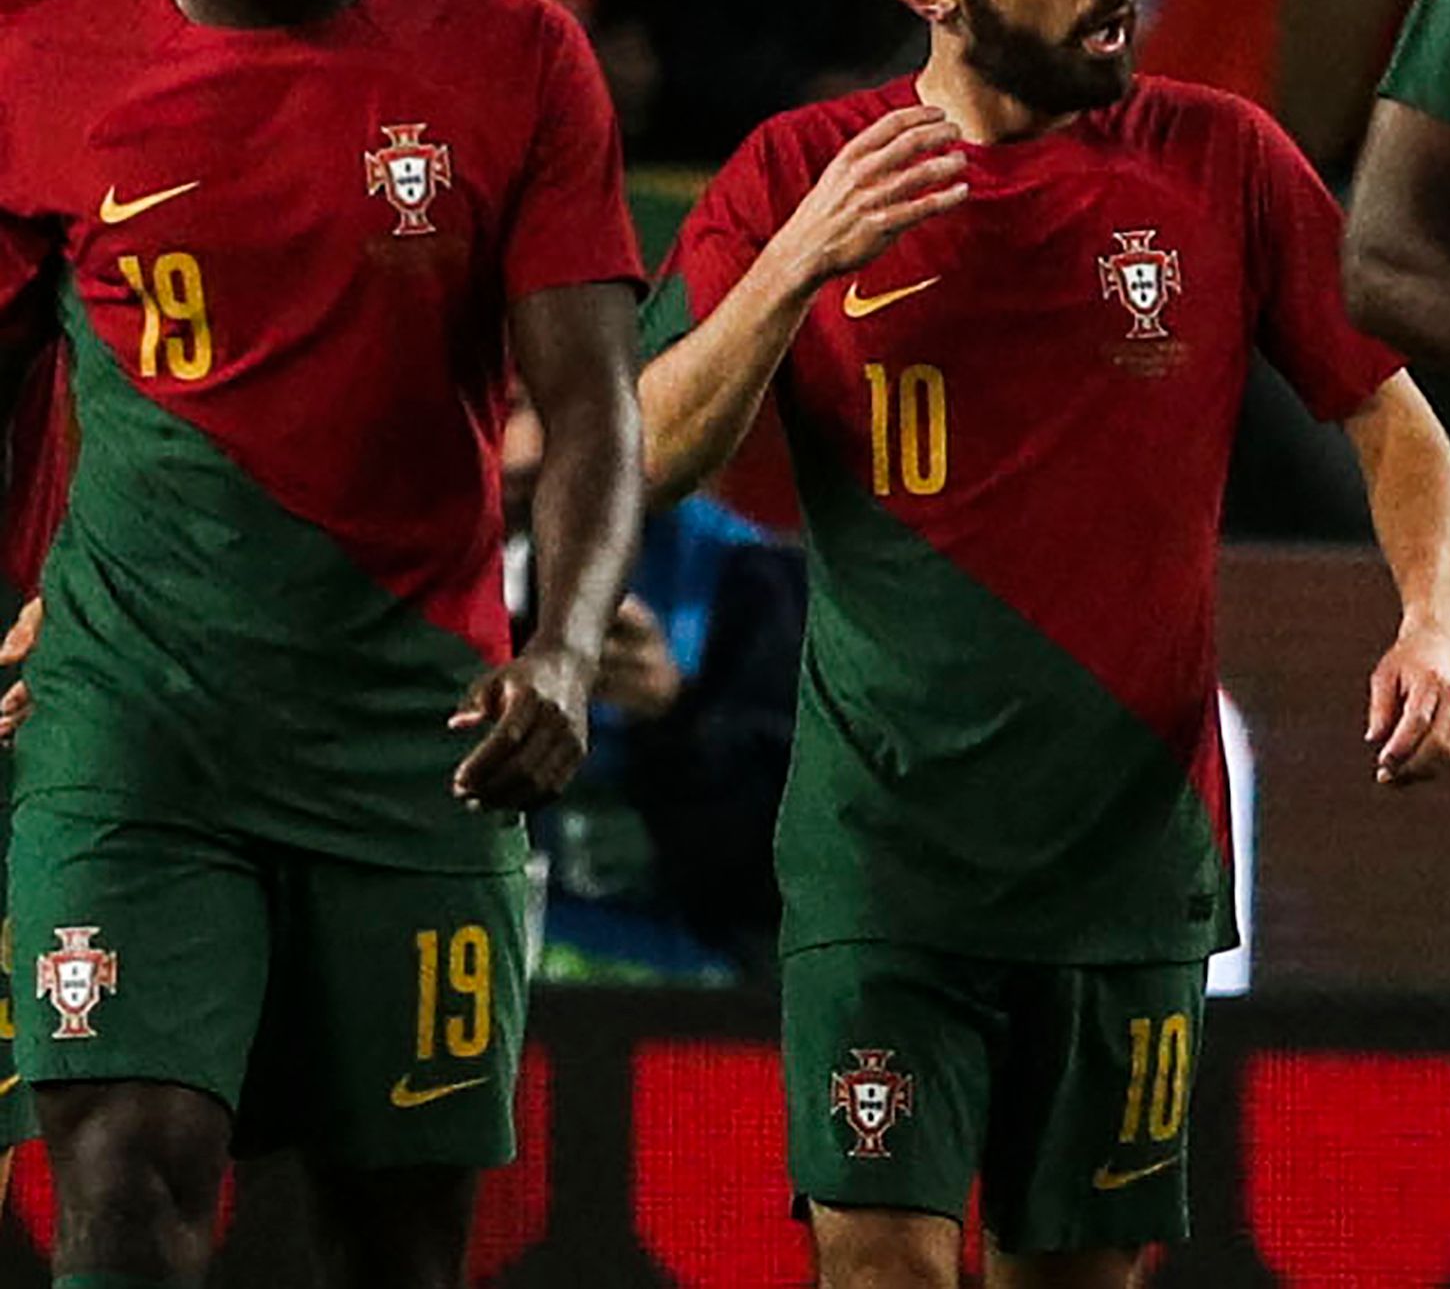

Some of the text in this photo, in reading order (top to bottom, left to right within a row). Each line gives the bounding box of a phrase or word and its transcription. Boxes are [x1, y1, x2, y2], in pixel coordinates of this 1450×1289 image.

[117, 252, 214, 381] 19
[863, 362, 950, 497] 10
[415, 924, 492, 1061] 19
[1118, 1012, 1190, 1144] 10
